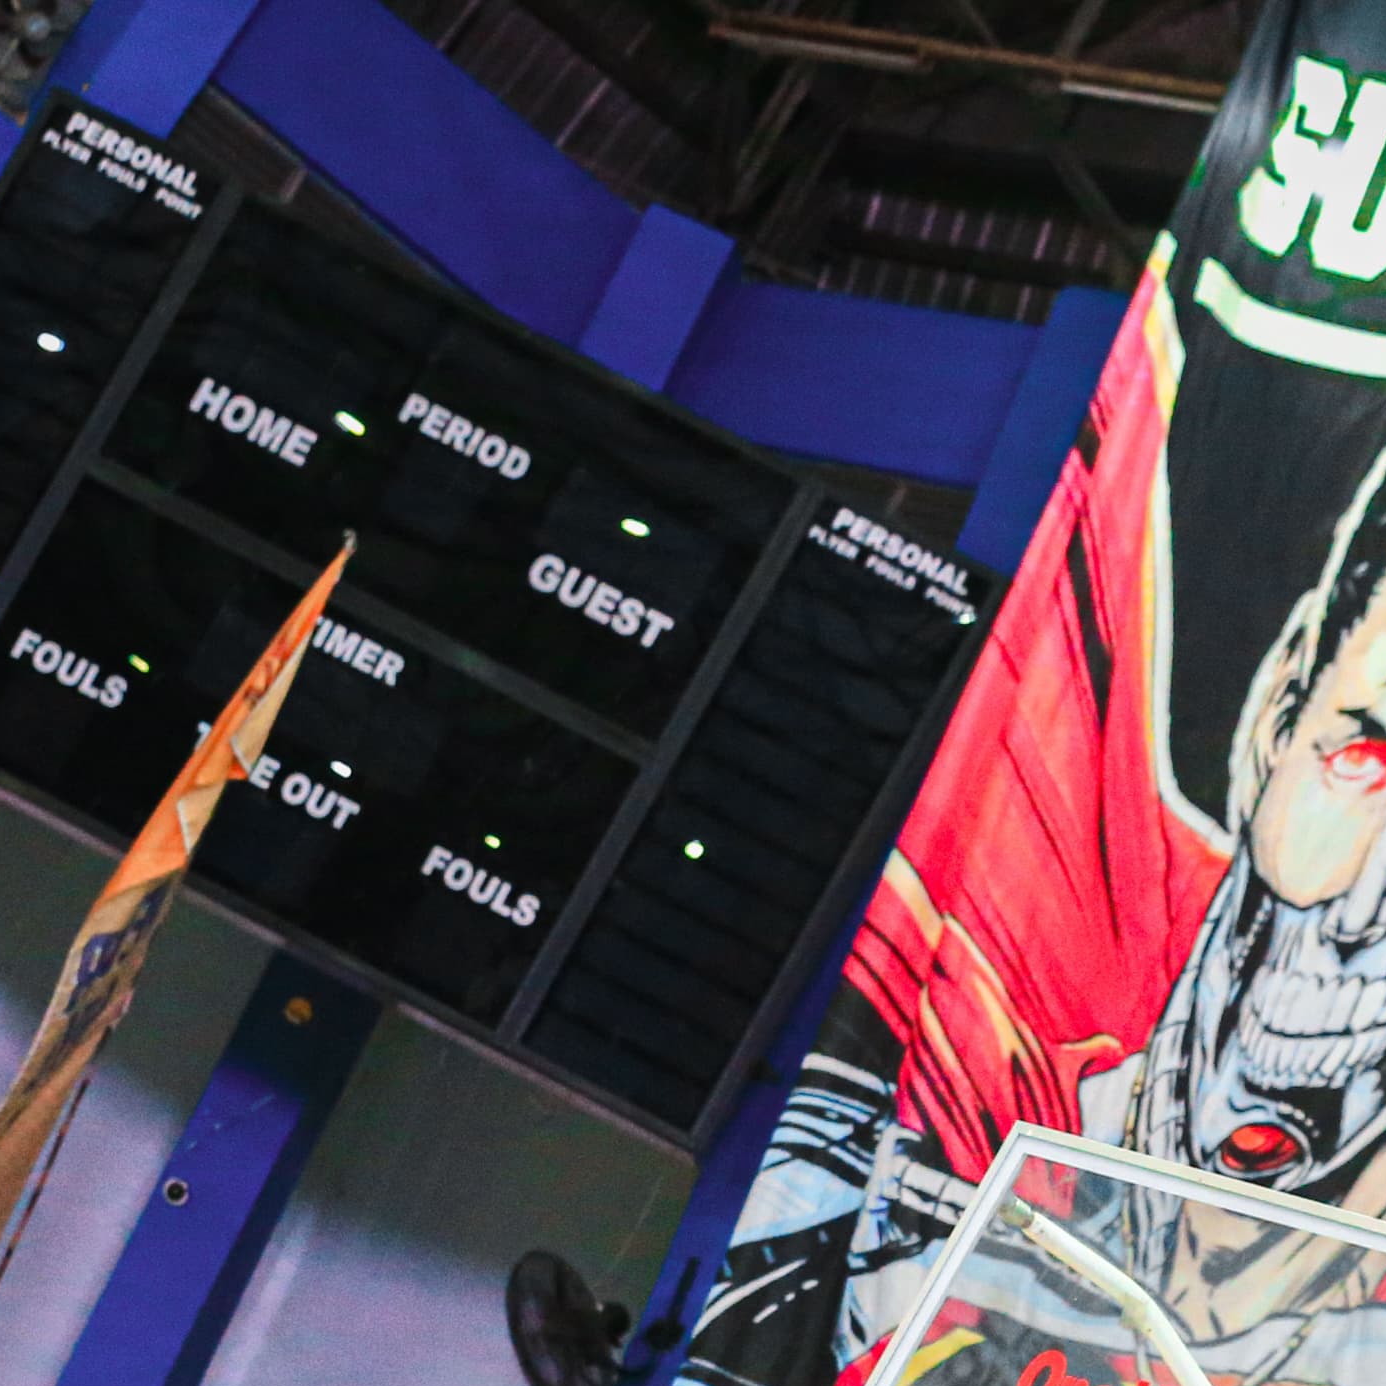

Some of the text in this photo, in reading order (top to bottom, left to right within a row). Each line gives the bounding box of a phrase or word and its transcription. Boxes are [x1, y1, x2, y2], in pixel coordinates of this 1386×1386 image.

[66, 112, 198, 197] PERSONAL
[188, 377, 318, 467] HOME
[398, 392, 531, 480] PERIOD
[832, 507, 968, 596] PERSONAL
[528, 554, 675, 649] GUEST
[10, 628, 128, 708] FOULS
[311, 616, 405, 687] IMER
[280, 772, 361, 830] OUT
[420, 844, 541, 927] FOULS
